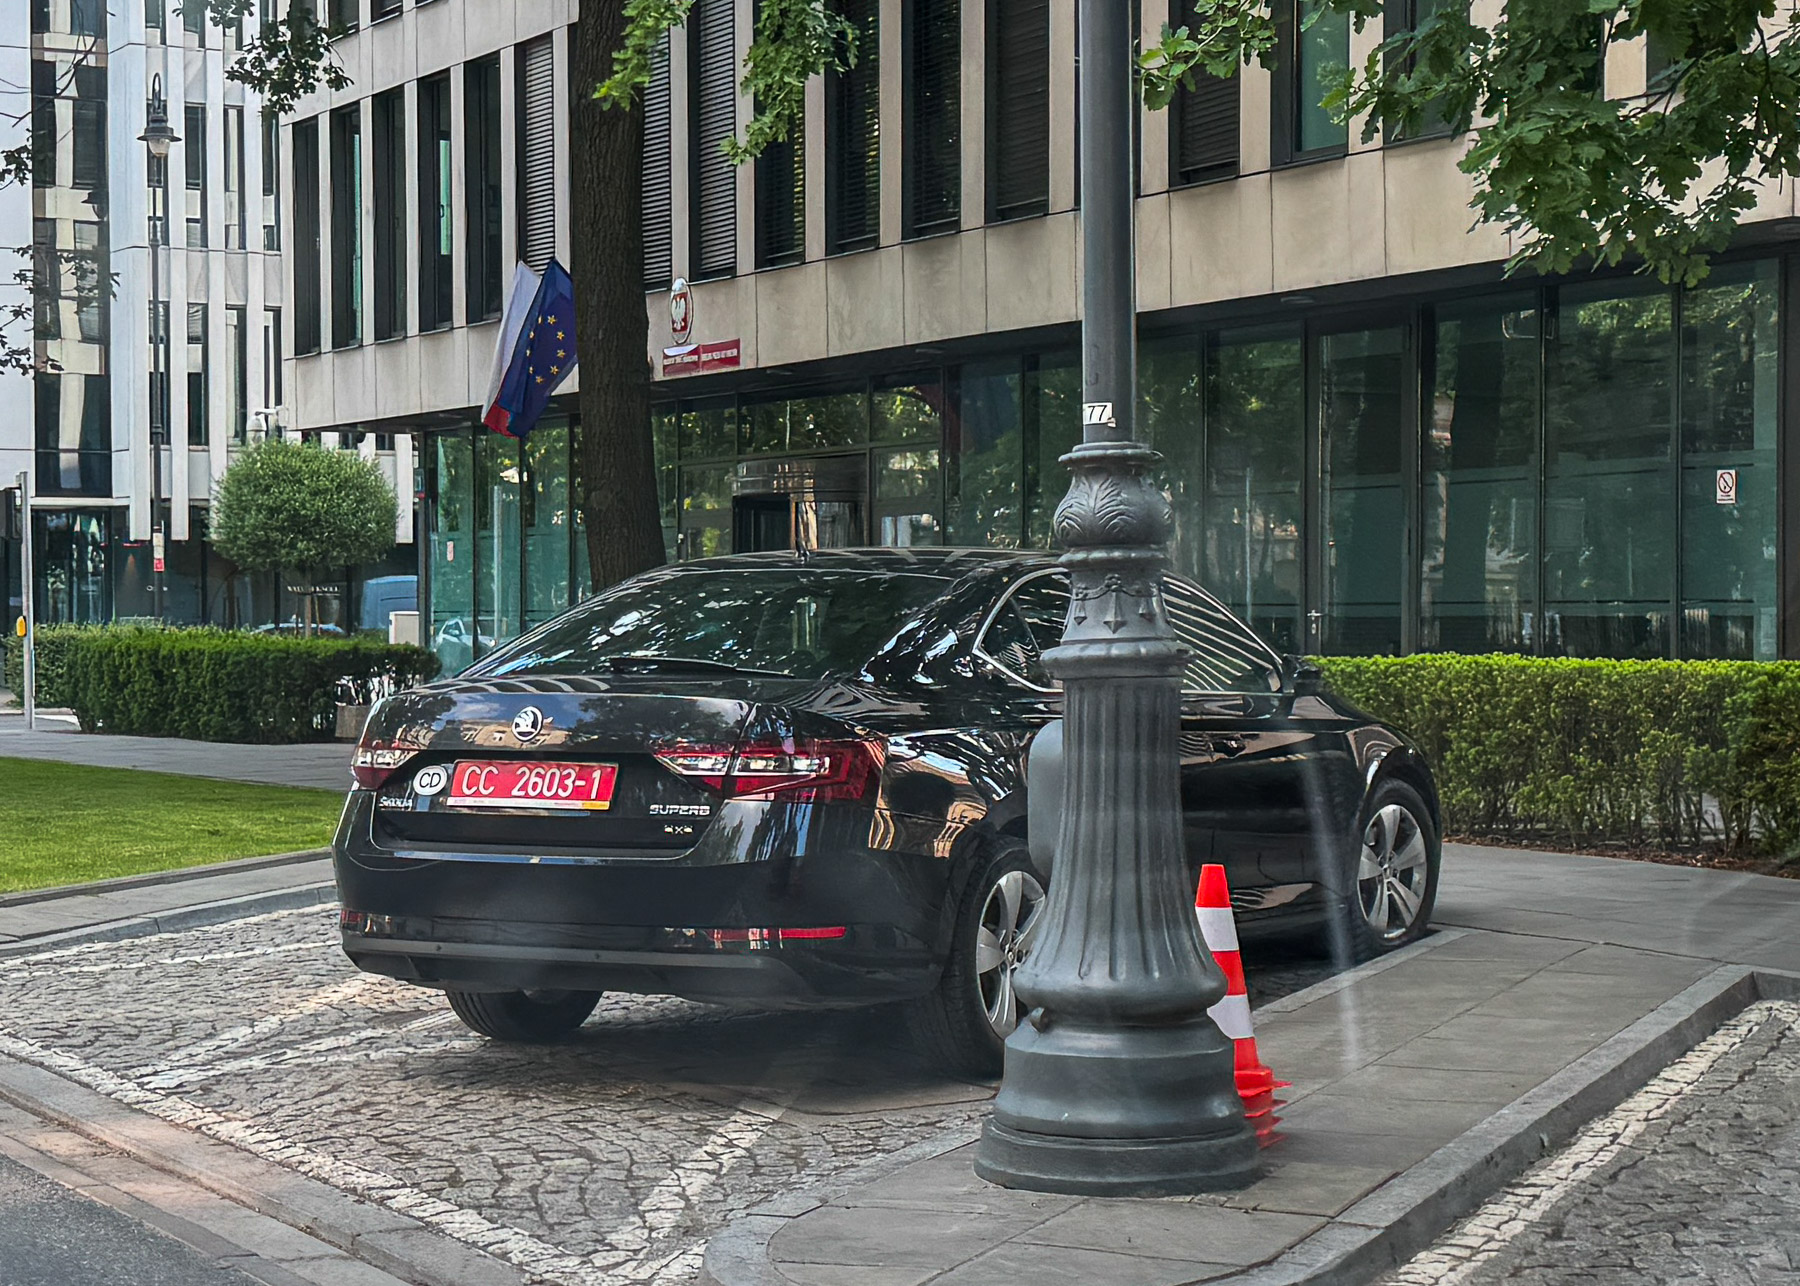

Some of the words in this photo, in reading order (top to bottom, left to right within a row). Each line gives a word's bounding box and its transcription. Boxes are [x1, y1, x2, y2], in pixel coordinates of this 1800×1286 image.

[1087, 404, 1107, 421] 77
[418, 772, 442, 788] CD
[461, 765, 499, 796] CC
[511, 766, 602, 800] 2603-1
[649, 803, 711, 816] SUPERB
